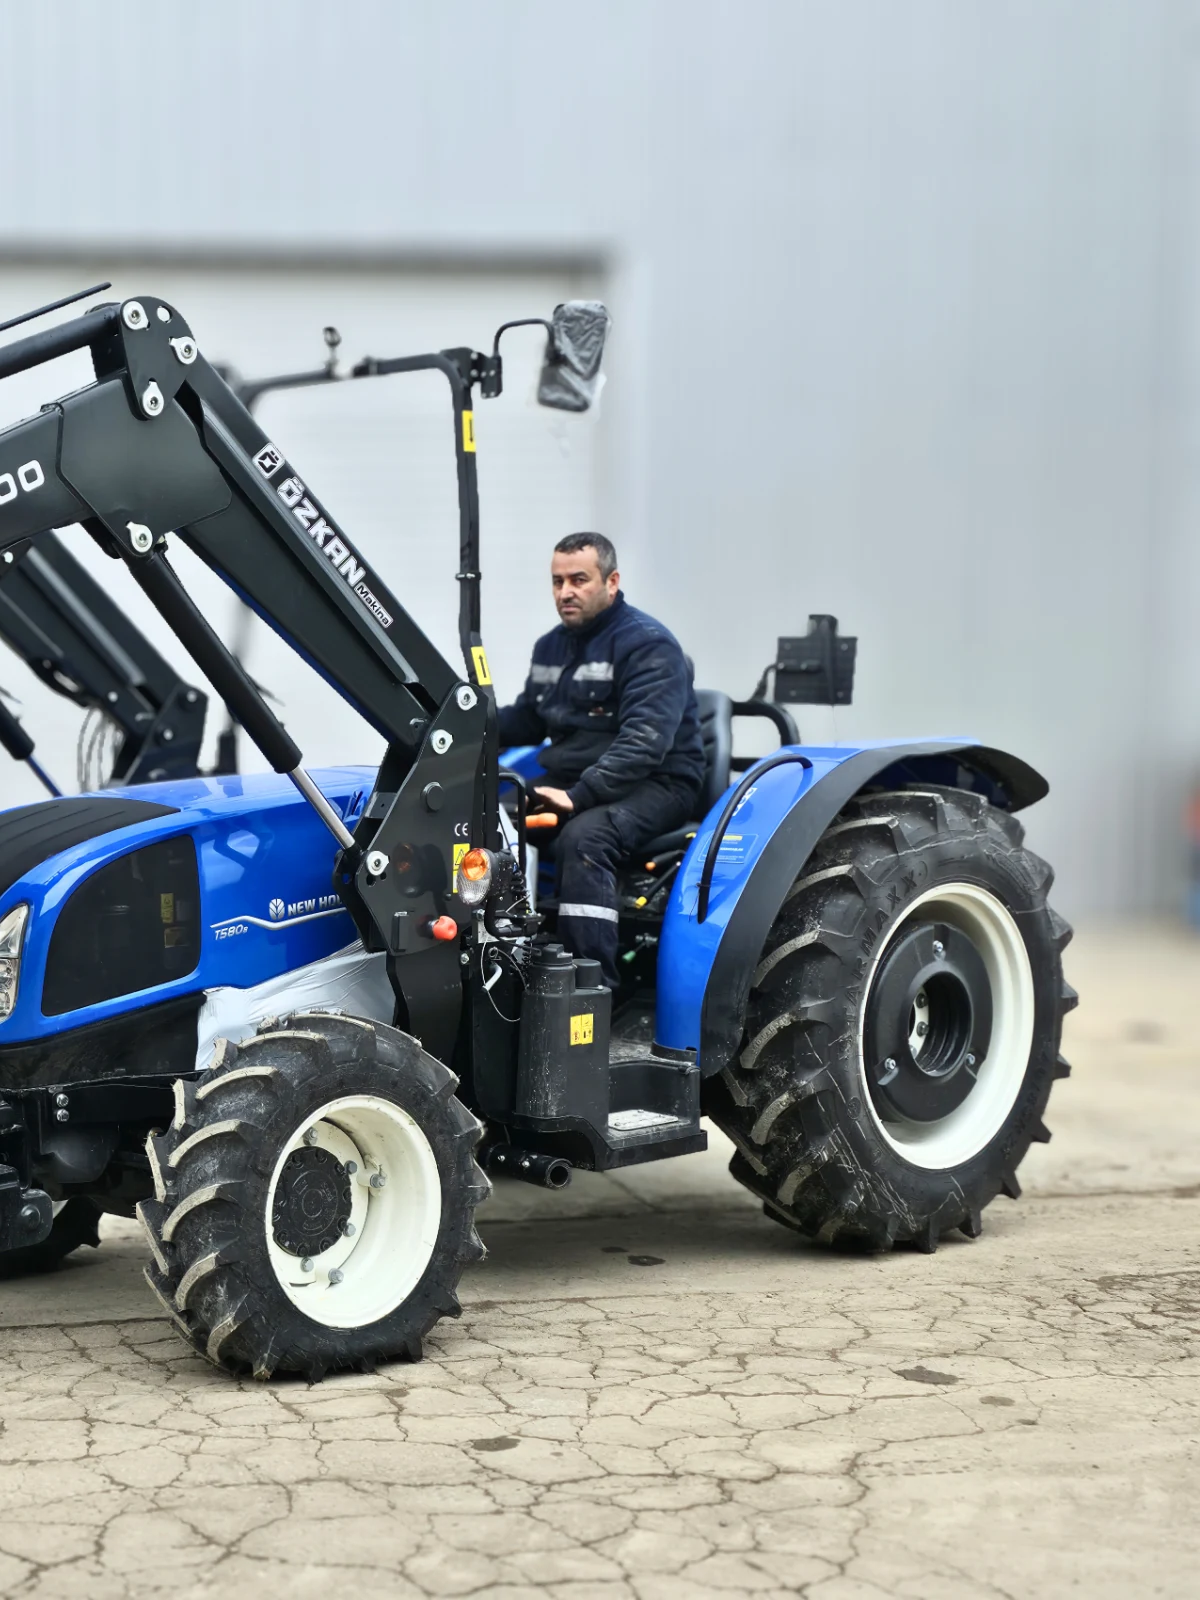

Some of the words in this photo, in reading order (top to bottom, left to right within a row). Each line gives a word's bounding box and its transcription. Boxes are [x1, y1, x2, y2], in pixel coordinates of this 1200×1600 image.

[276, 476, 367, 588] ÖZKAN
[356, 584, 390, 626] Makina
[454, 822, 469, 837] CE
[288, 898, 316, 916] NEW
[838, 869, 918, 1056] TARMAXX
